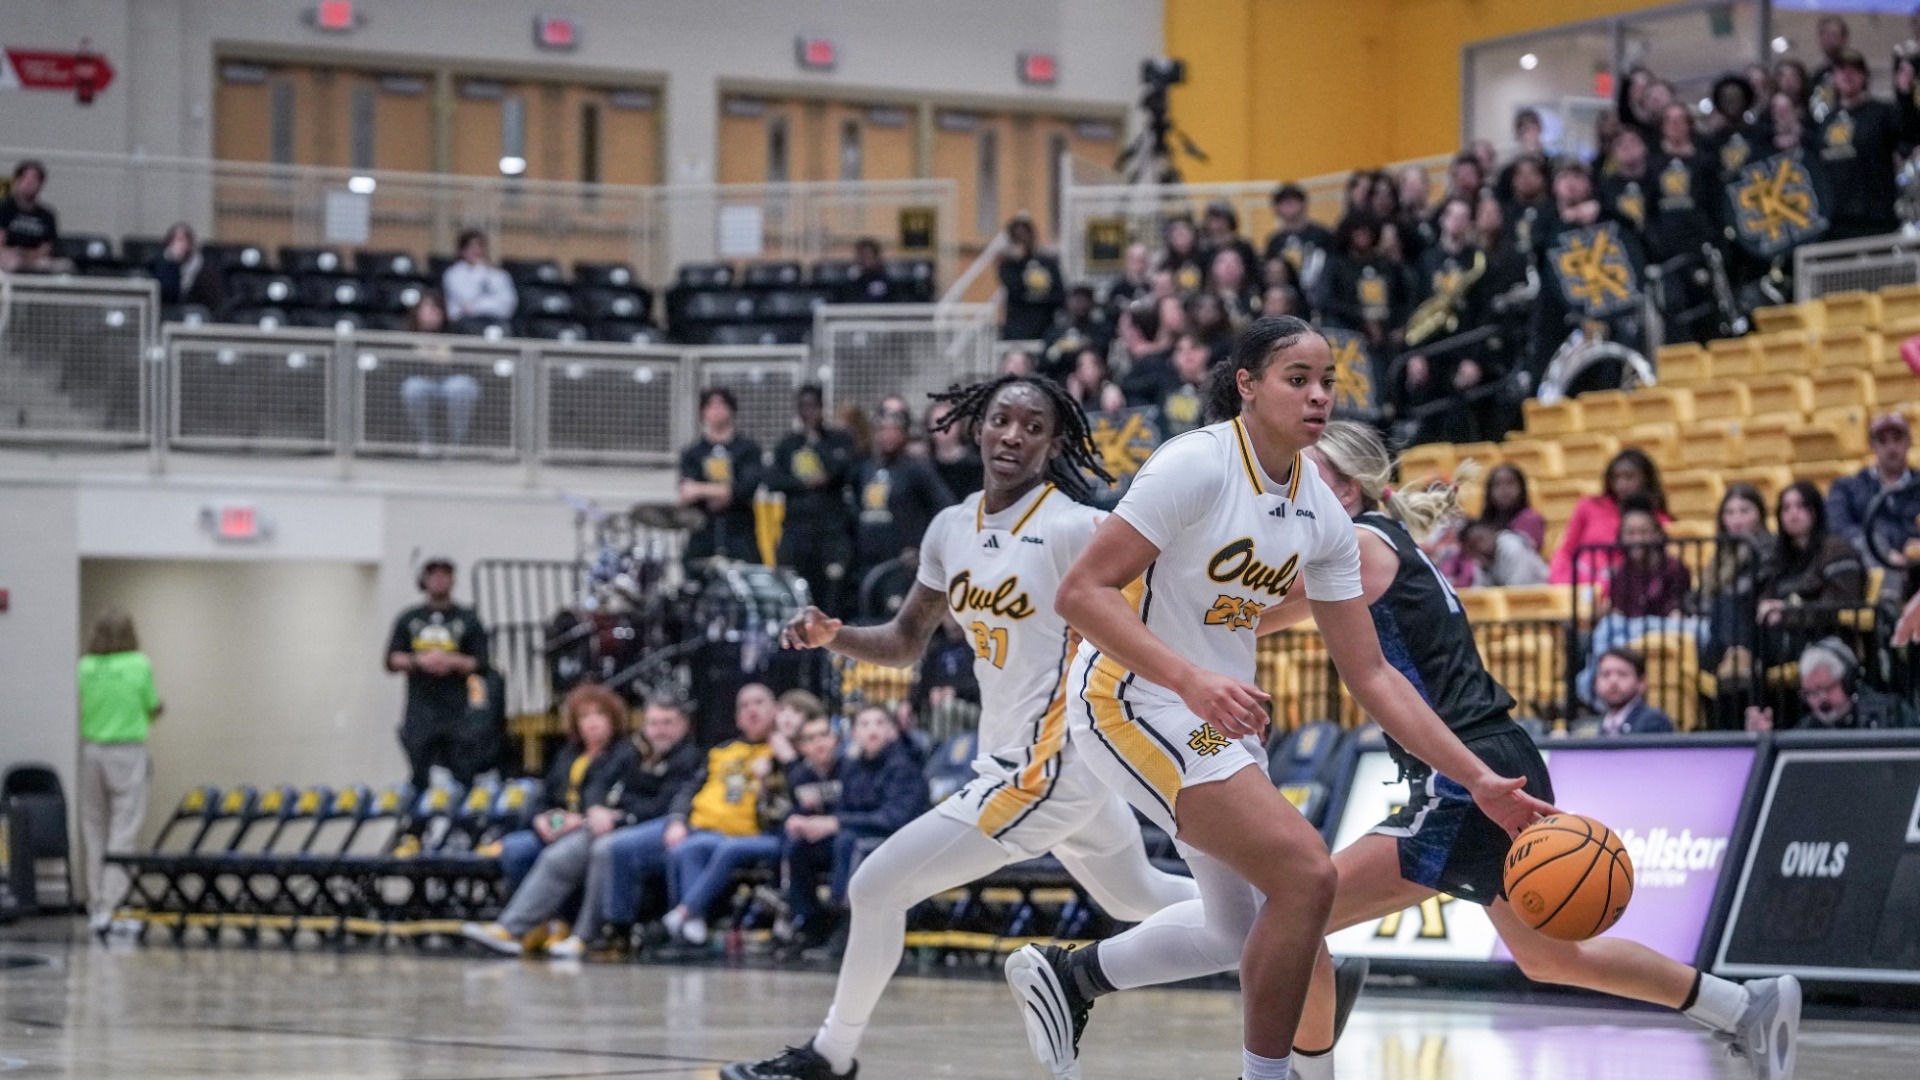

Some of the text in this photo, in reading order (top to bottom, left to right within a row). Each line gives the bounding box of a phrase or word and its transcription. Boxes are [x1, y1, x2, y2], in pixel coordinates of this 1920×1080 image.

[948, 568, 1036, 619] Owls
[968, 620, 1008, 670] 21
[1780, 840, 1850, 878] OWLS
